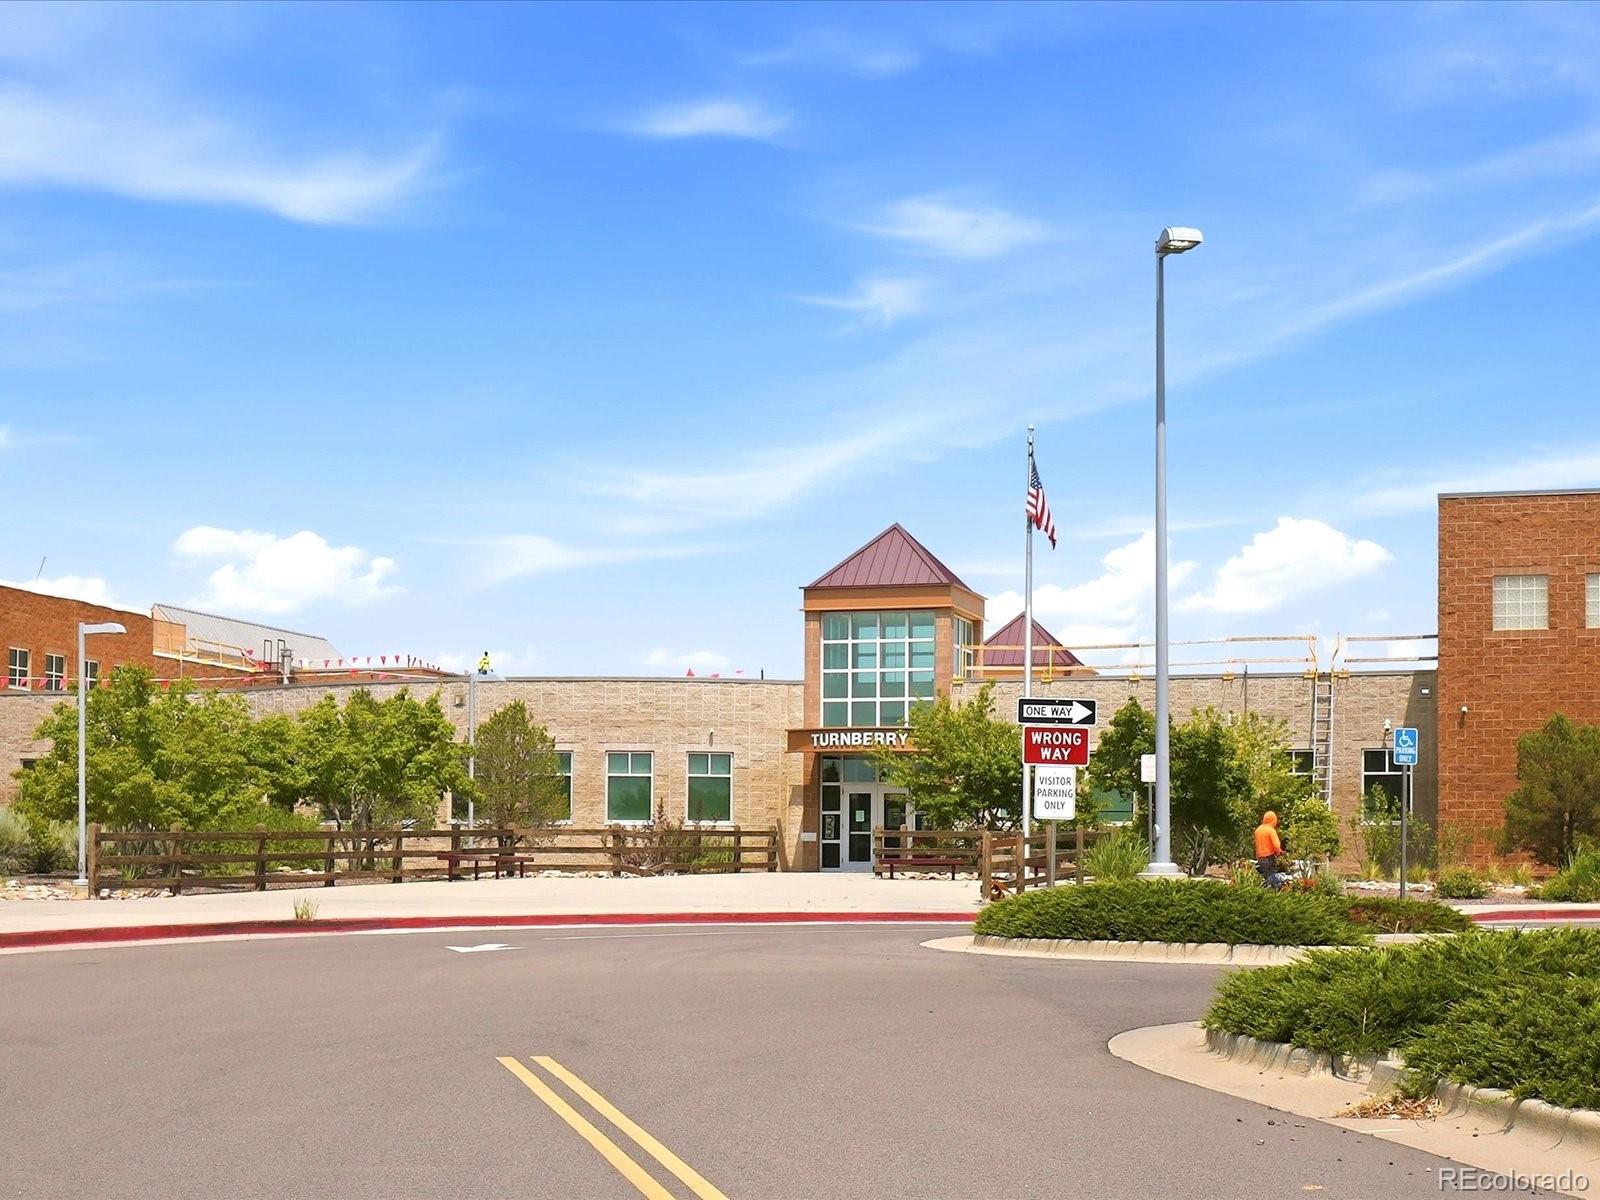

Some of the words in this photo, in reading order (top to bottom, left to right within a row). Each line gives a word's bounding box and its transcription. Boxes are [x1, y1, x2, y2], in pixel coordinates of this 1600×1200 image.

[1026, 706, 1047, 716] ONE
[1051, 707, 1073, 716] WAY
[811, 732, 909, 747] TURNBERRY
[1031, 732, 1082, 745] WRONG
[1041, 748, 1072, 760] WAY
[1039, 776, 1072, 785] VISITOR
[1036, 788, 1074, 798] PARKING
[1044, 800, 1066, 810] ONLY
